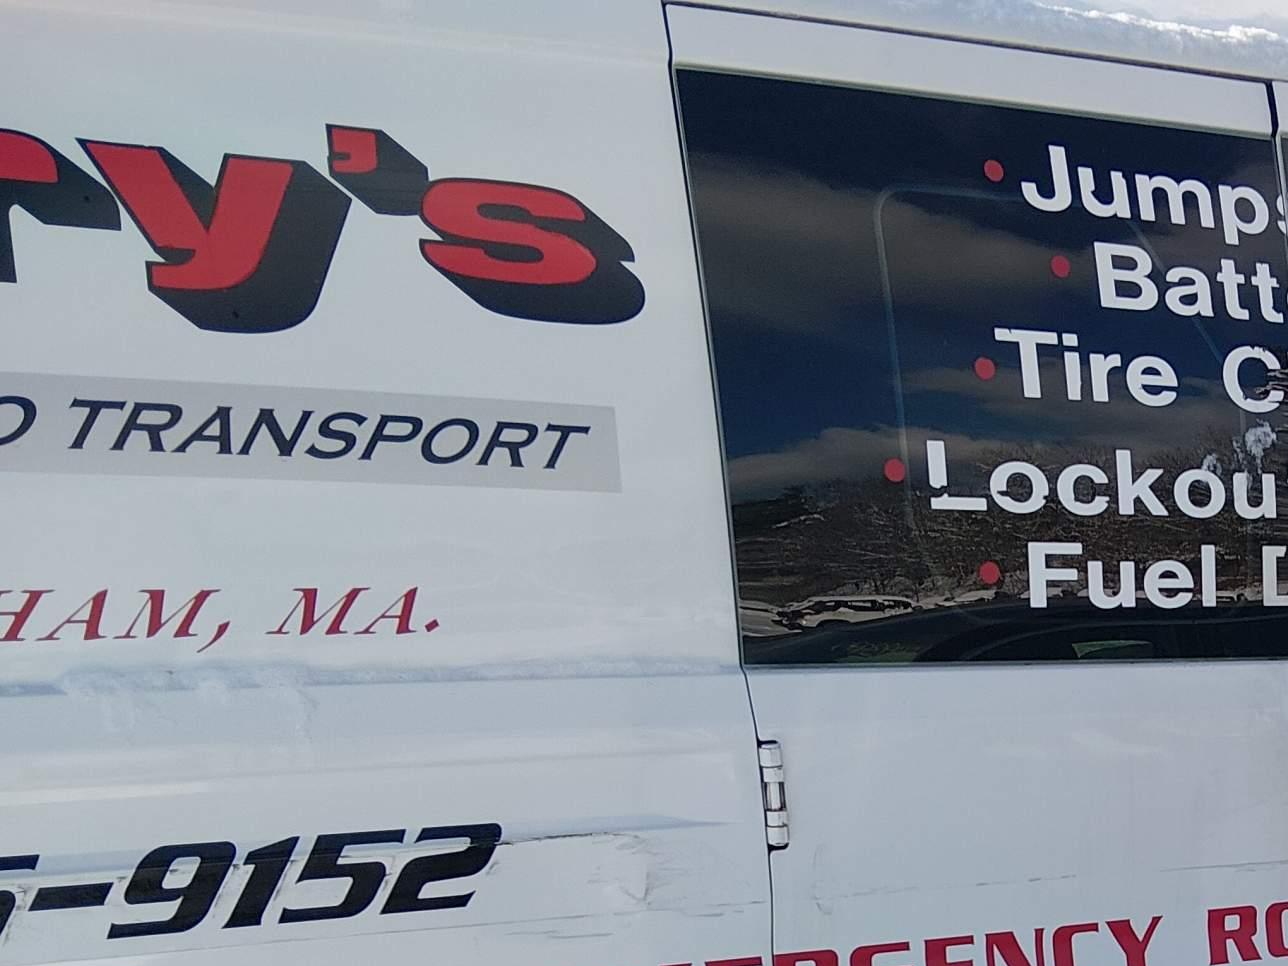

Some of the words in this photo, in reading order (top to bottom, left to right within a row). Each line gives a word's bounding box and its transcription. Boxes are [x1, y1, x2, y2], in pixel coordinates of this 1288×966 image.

[994, 326, 1179, 407] Tire
[68, 397, 591, 470] TRANSPORT
[1027, 541, 1217, 609] Fuel
[266, 586, 441, 636] MA.
